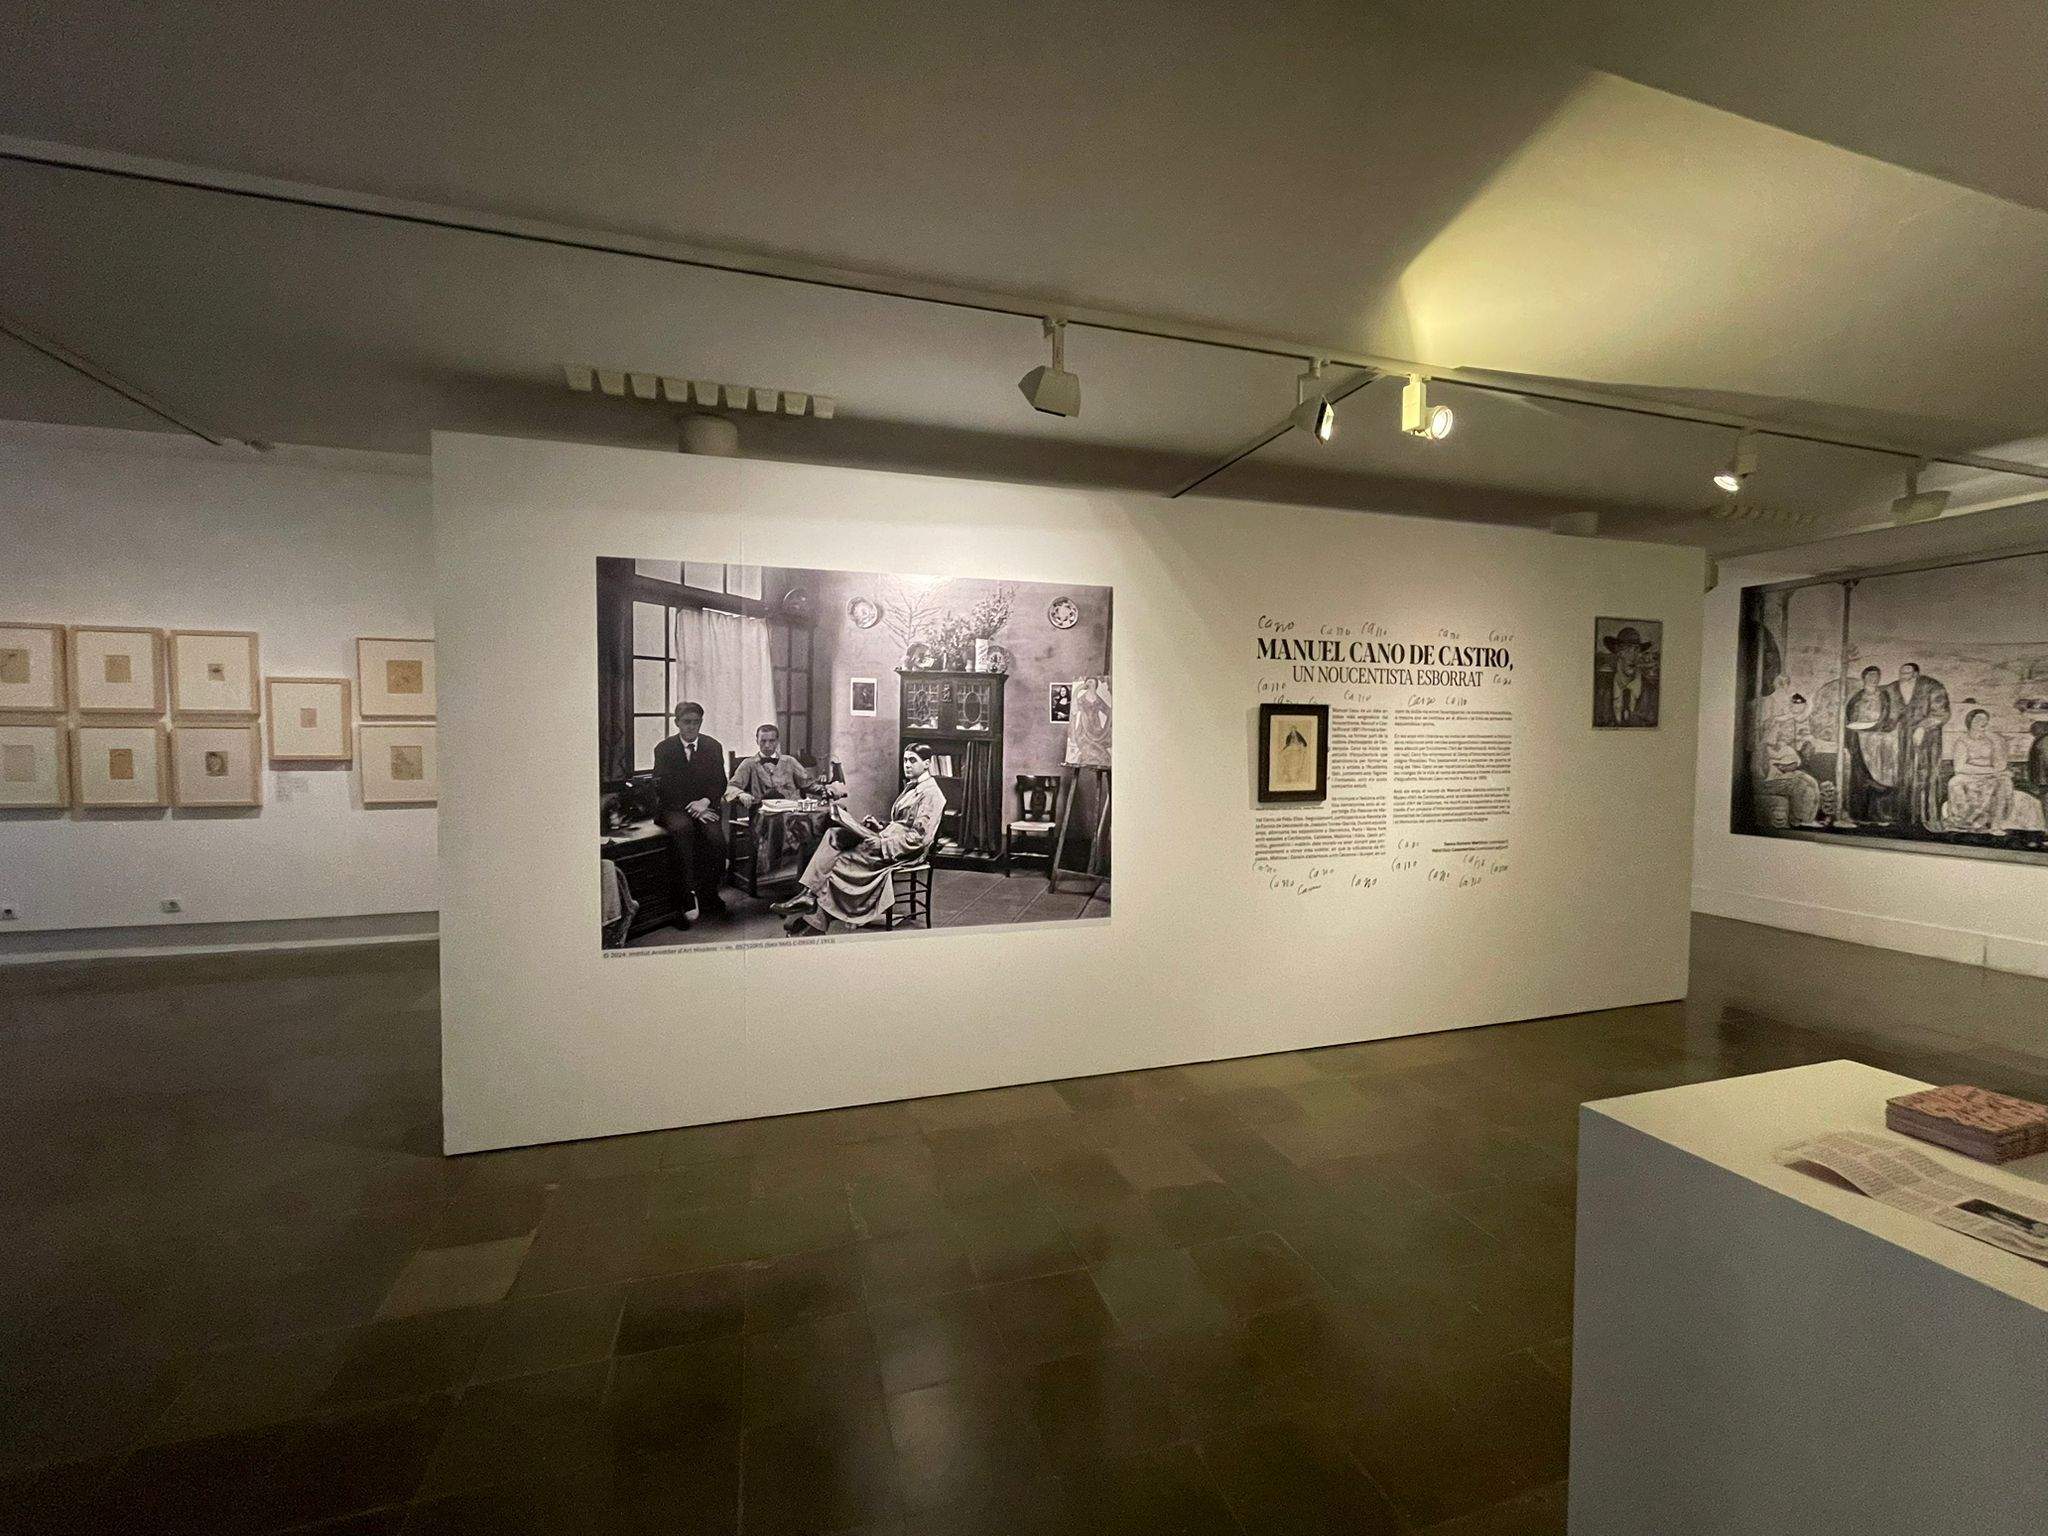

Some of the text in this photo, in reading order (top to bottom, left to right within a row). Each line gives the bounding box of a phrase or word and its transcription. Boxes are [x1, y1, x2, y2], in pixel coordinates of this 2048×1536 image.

[1257, 637, 1514, 671] MANUEL CANO DE CASTRO,
[1293, 665, 1484, 687] UN NOUCENTISTA ESBORRAT
